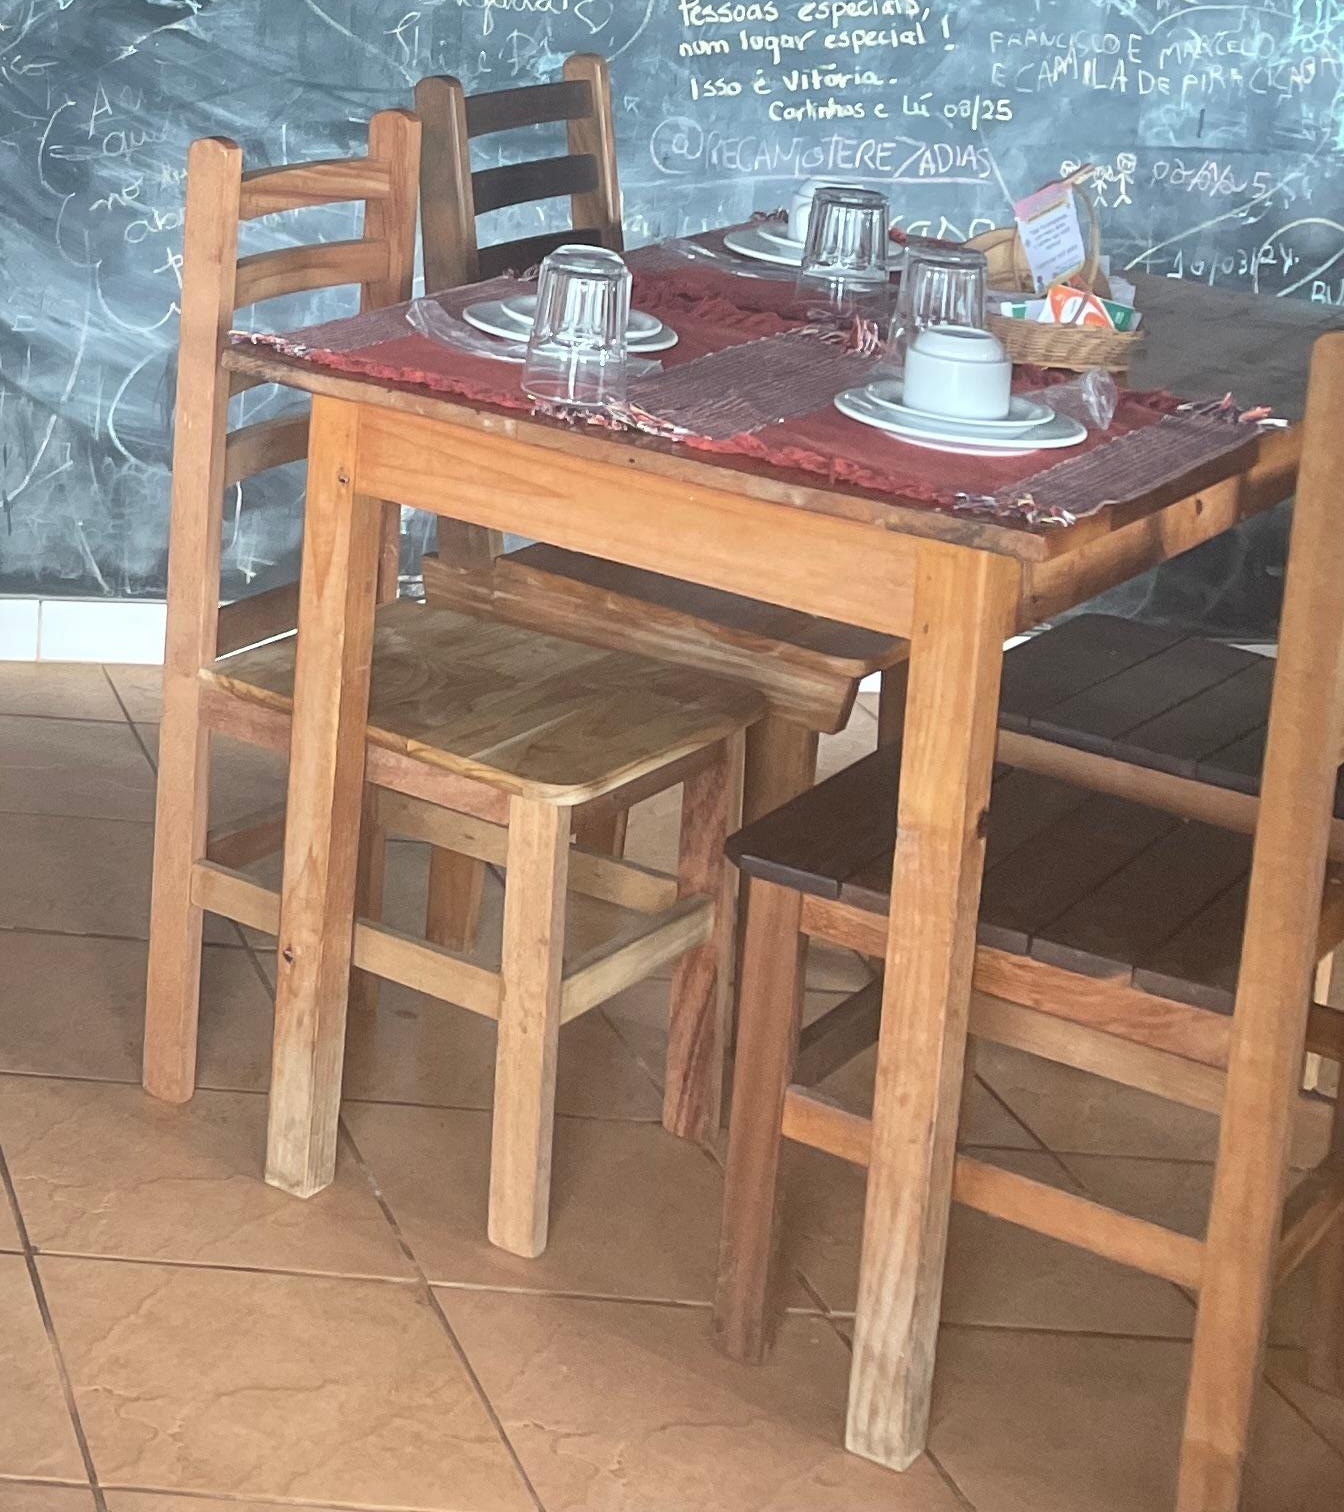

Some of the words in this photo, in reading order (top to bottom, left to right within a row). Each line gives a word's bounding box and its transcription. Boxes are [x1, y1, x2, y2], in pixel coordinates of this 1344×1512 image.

[678, 38, 729, 58] num
[740, 30, 814, 65] lugar
[690, 78, 742, 100] Isso
[752, 70, 773, 95] é
[768, 100, 865, 122] Carlinhos
[874, 105, 889, 119] e
